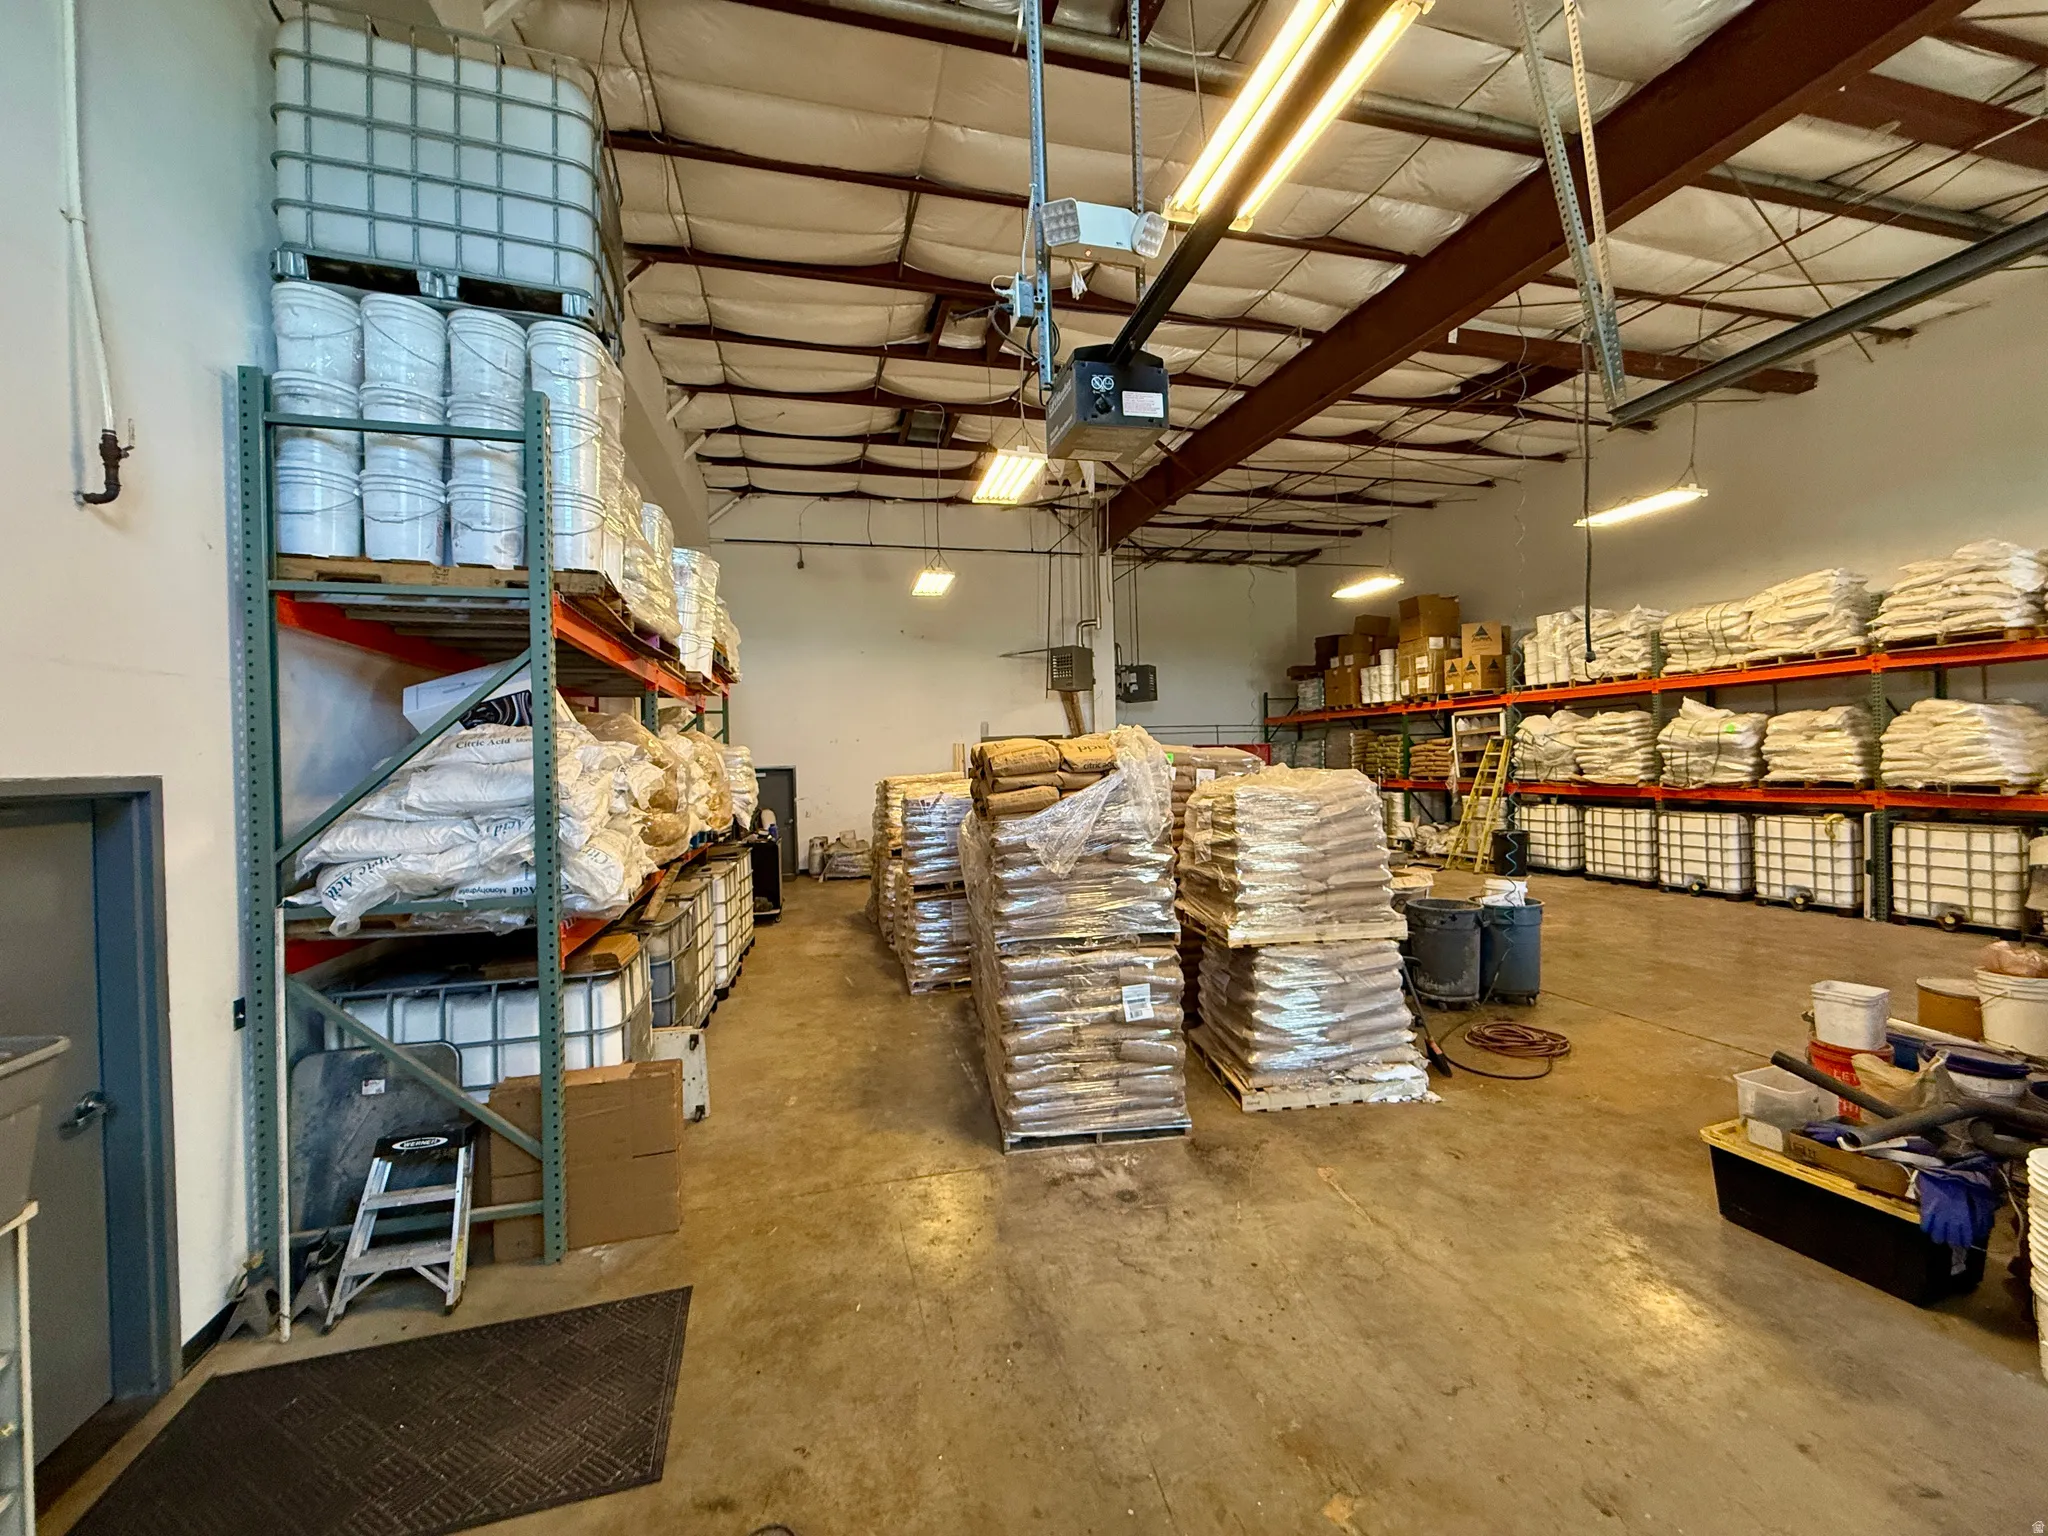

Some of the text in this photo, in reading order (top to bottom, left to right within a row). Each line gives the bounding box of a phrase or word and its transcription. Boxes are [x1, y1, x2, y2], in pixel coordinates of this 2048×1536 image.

[456, 740, 485, 749] Citric
[487, 738, 511, 746] Acid
[326, 872, 353, 901] Acid
[512, 886, 536, 896] Acid
[403, 1138, 437, 1148] WERNER
